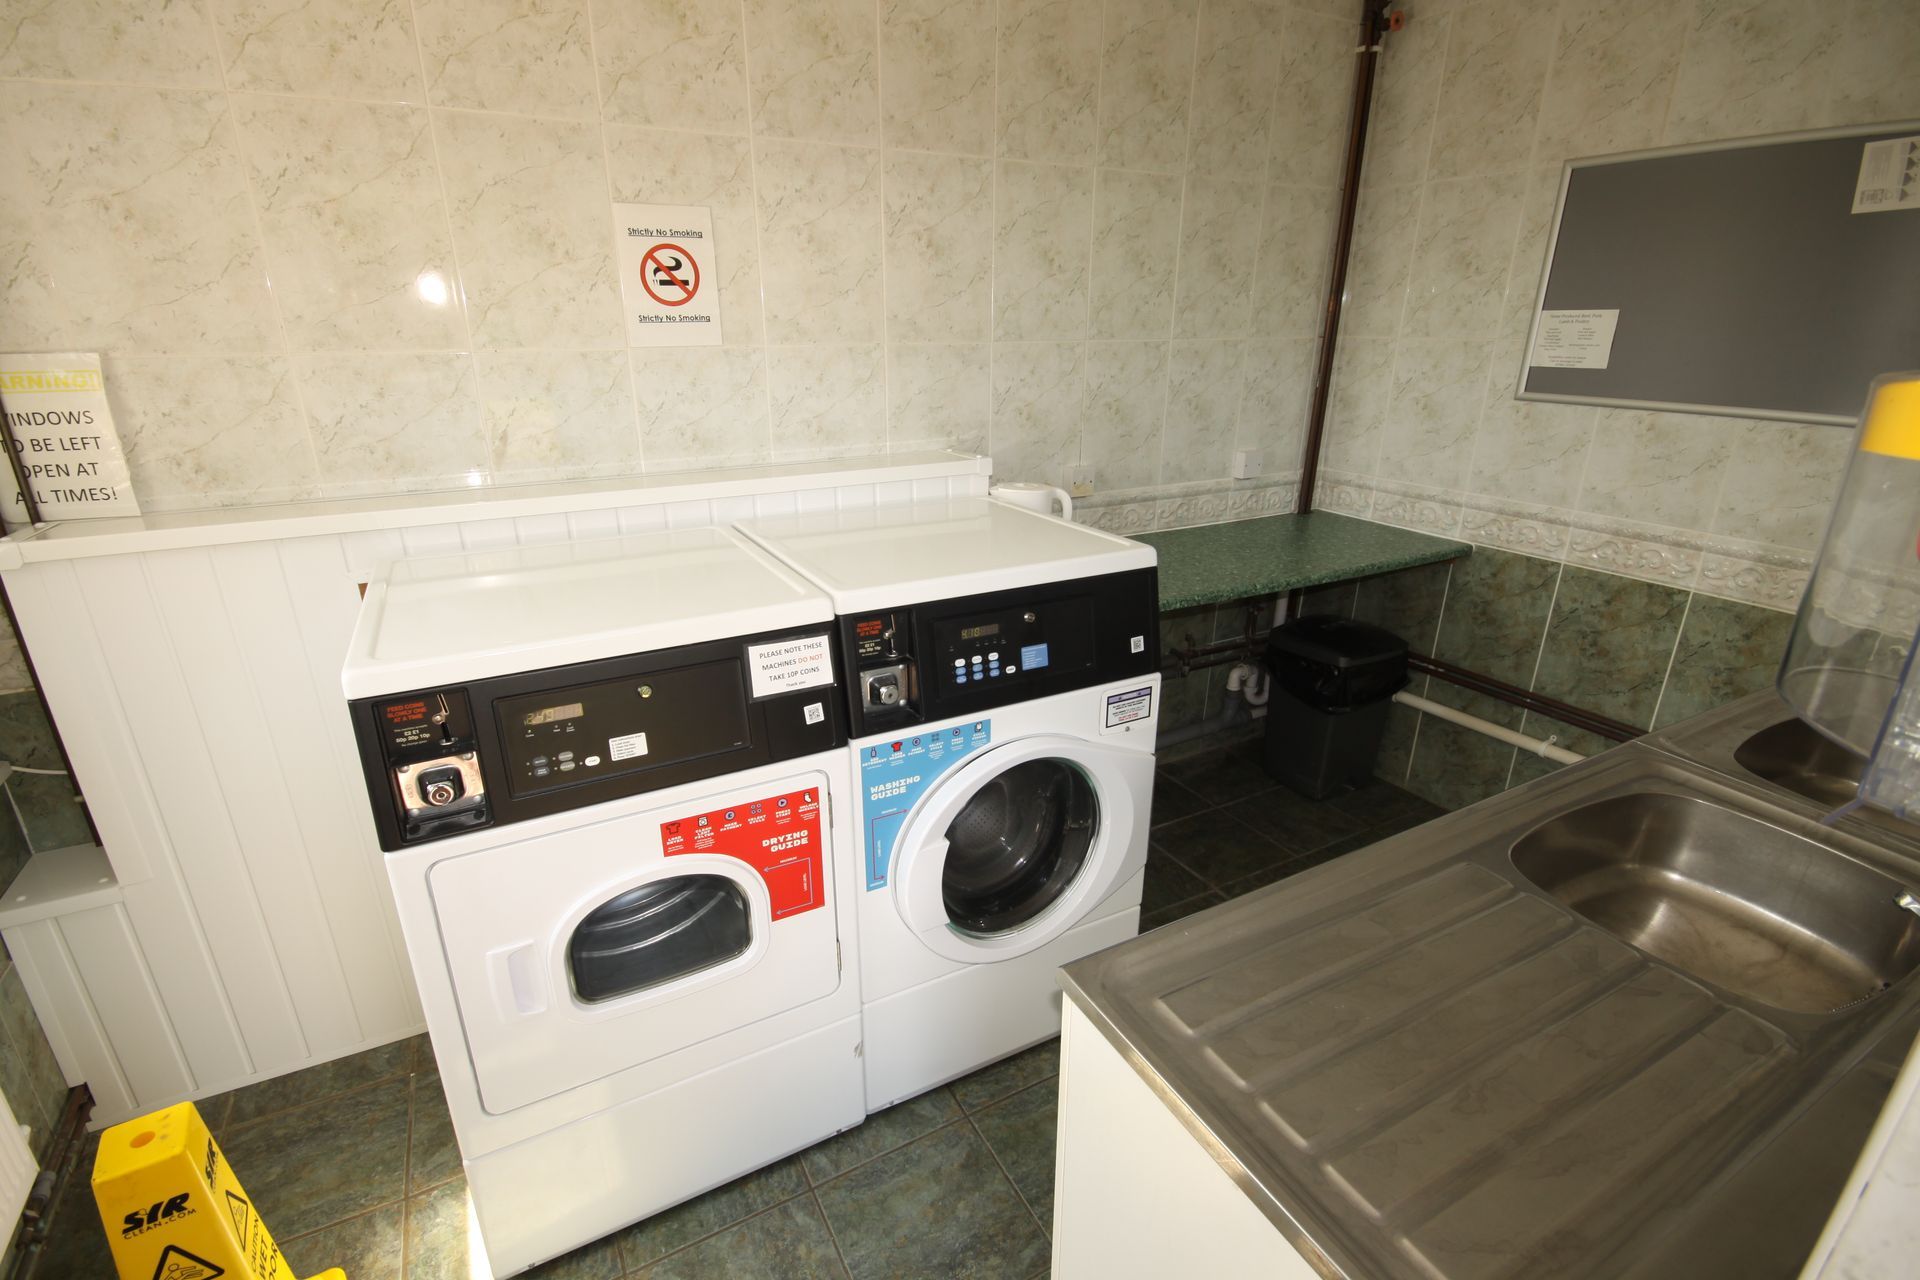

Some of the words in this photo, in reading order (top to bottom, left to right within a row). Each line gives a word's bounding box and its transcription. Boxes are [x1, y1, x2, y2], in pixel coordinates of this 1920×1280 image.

[627, 228, 653, 237] Strictly
[656, 229, 667, 237] No
[669, 229, 703, 238] Smoking
[638, 315, 663, 323] Strictly
[678, 314, 710, 323] Smoking
[6, 410, 94, 426] INDOWS
[30, 438, 55, 452] BE
[59, 436, 101, 451] LEFT
[77, 462, 99, 476] AT
[50, 486, 118, 503] TIMES!
[759, 649, 782, 659] PLEASE
[784, 646, 802, 654] NOTE
[803, 641, 822, 650] THESE
[762, 659, 797, 671] MACHINES
[798, 656, 808, 664] DO
[809, 653, 823, 662] NOT
[769, 673, 785, 682] TAKE
[800, 666, 820, 675] COINS
[870, 775, 920, 793] WASHING
[871, 786, 906, 800] GUIDE
[762, 829, 808, 847] DRYING
[770, 837, 808, 852] GUIDE
[122, 1192, 190, 1236] SIR
[123, 1208, 197, 1240] CLEAN.COM
